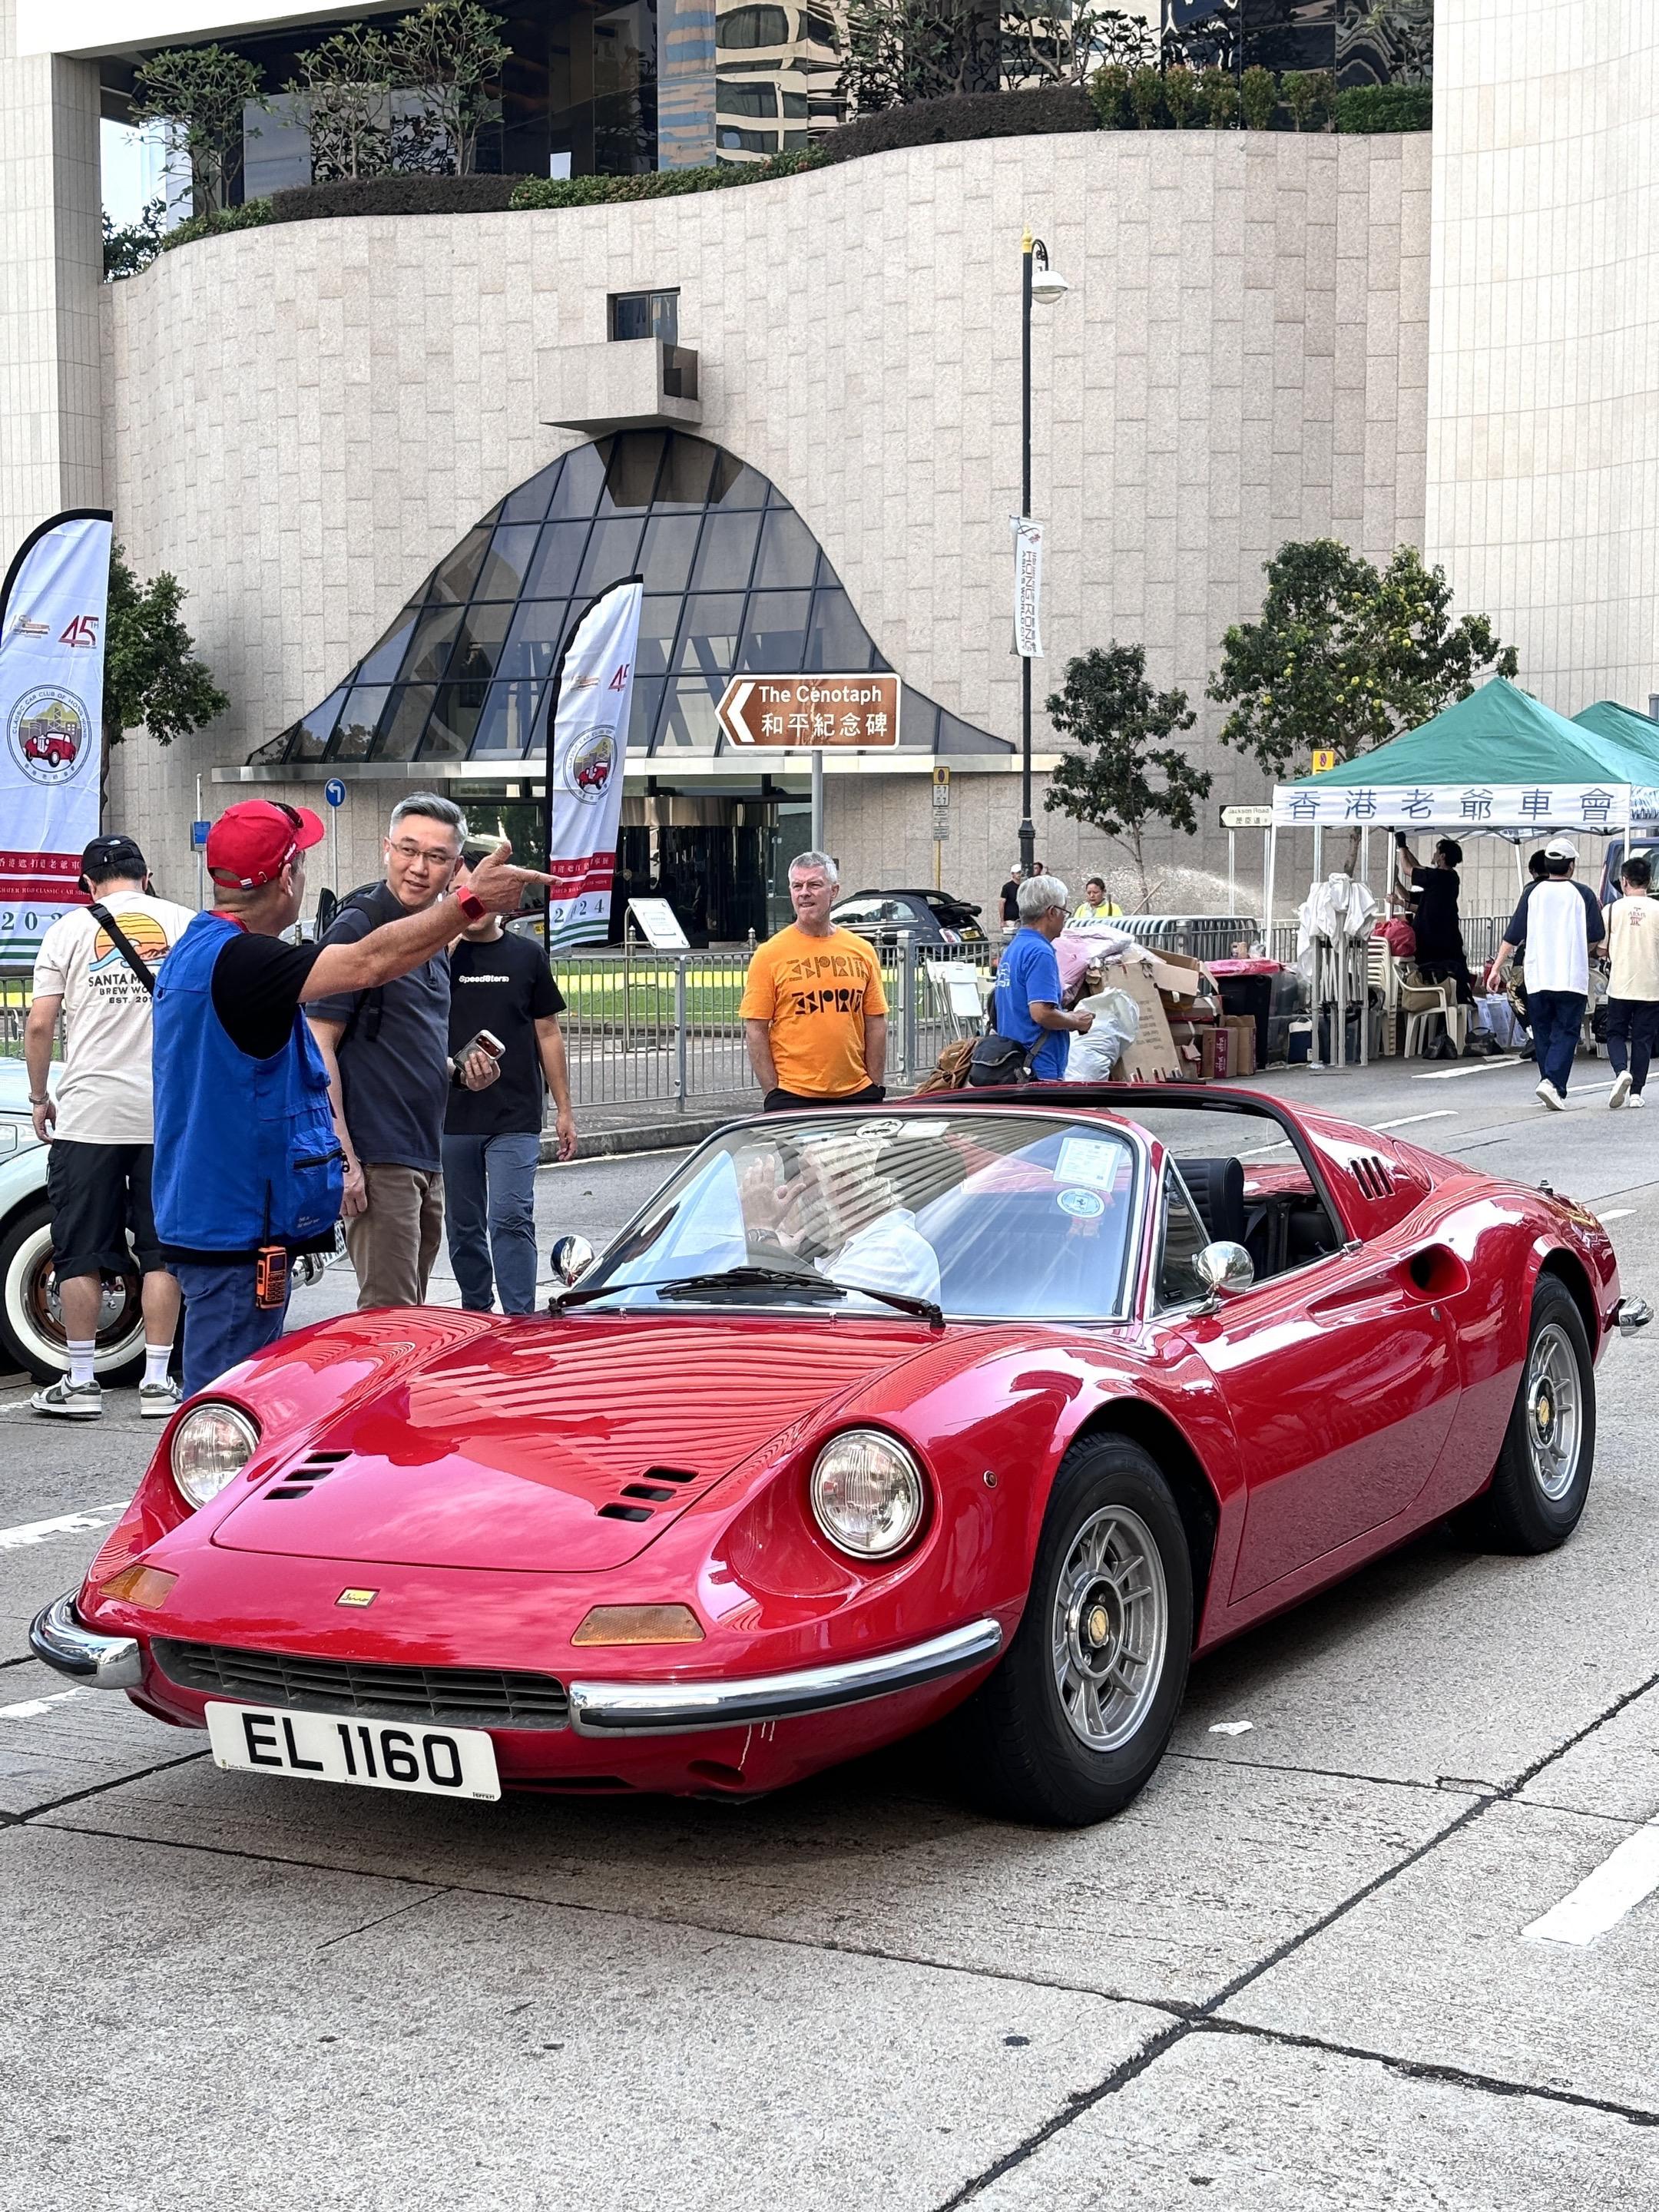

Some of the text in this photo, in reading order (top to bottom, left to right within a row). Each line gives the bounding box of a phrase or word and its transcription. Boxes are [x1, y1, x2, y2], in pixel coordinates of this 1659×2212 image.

[58, 615, 99, 647] 45
[25, 694, 37, 705] CAR
[759, 684, 882, 706] The Cenotaph
[761, 712, 888, 737] 和平紀念碑
[1288, 787, 1616, 823] 香港老爺車會
[88, 974, 128, 987] SANTA
[99, 986, 128, 995] BREW
[241, 1712, 464, 1788] EL 1160
